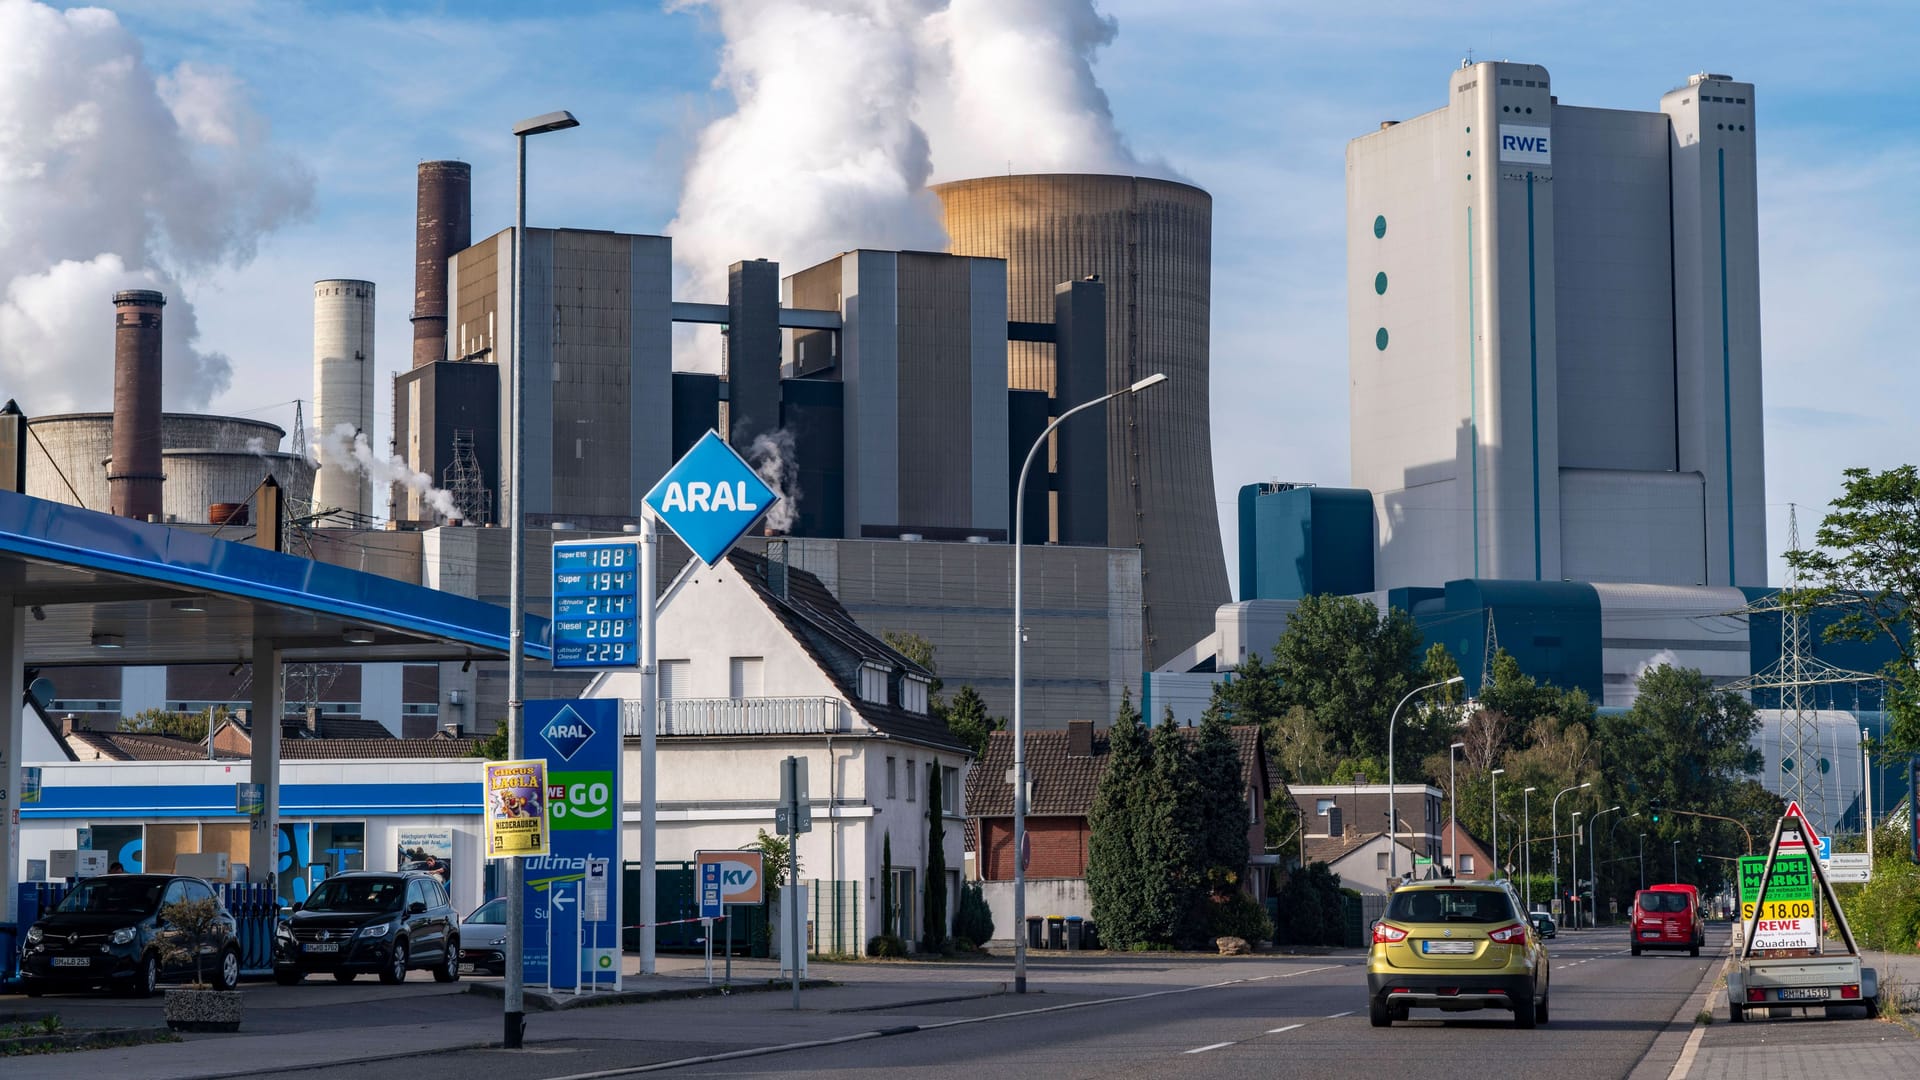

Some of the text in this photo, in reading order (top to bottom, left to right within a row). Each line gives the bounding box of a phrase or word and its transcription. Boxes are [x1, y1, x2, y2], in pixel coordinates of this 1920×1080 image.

[1503, 135, 1548, 152] RWE
[662, 481, 757, 512] ARAL
[593, 549, 624, 567] 188
[558, 575, 581, 584] Super
[593, 573, 624, 590] 194
[586, 596, 624, 614] 214
[558, 622, 582, 630] Diesel
[586, 620, 624, 638] 208
[586, 644, 624, 661] 229
[548, 725, 587, 738] ARAL
[494, 768, 534, 776] CIRCUS
[492, 776, 538, 790] LAOLA
[569, 782, 608, 805] GO
[253, 821, 258, 829] 2
[1769, 903, 1814, 918] 18.09.
[1759, 920, 1800, 931] REWE
[1756, 938, 1806, 948] Quadrath
[1783, 989, 1794, 998] BM
